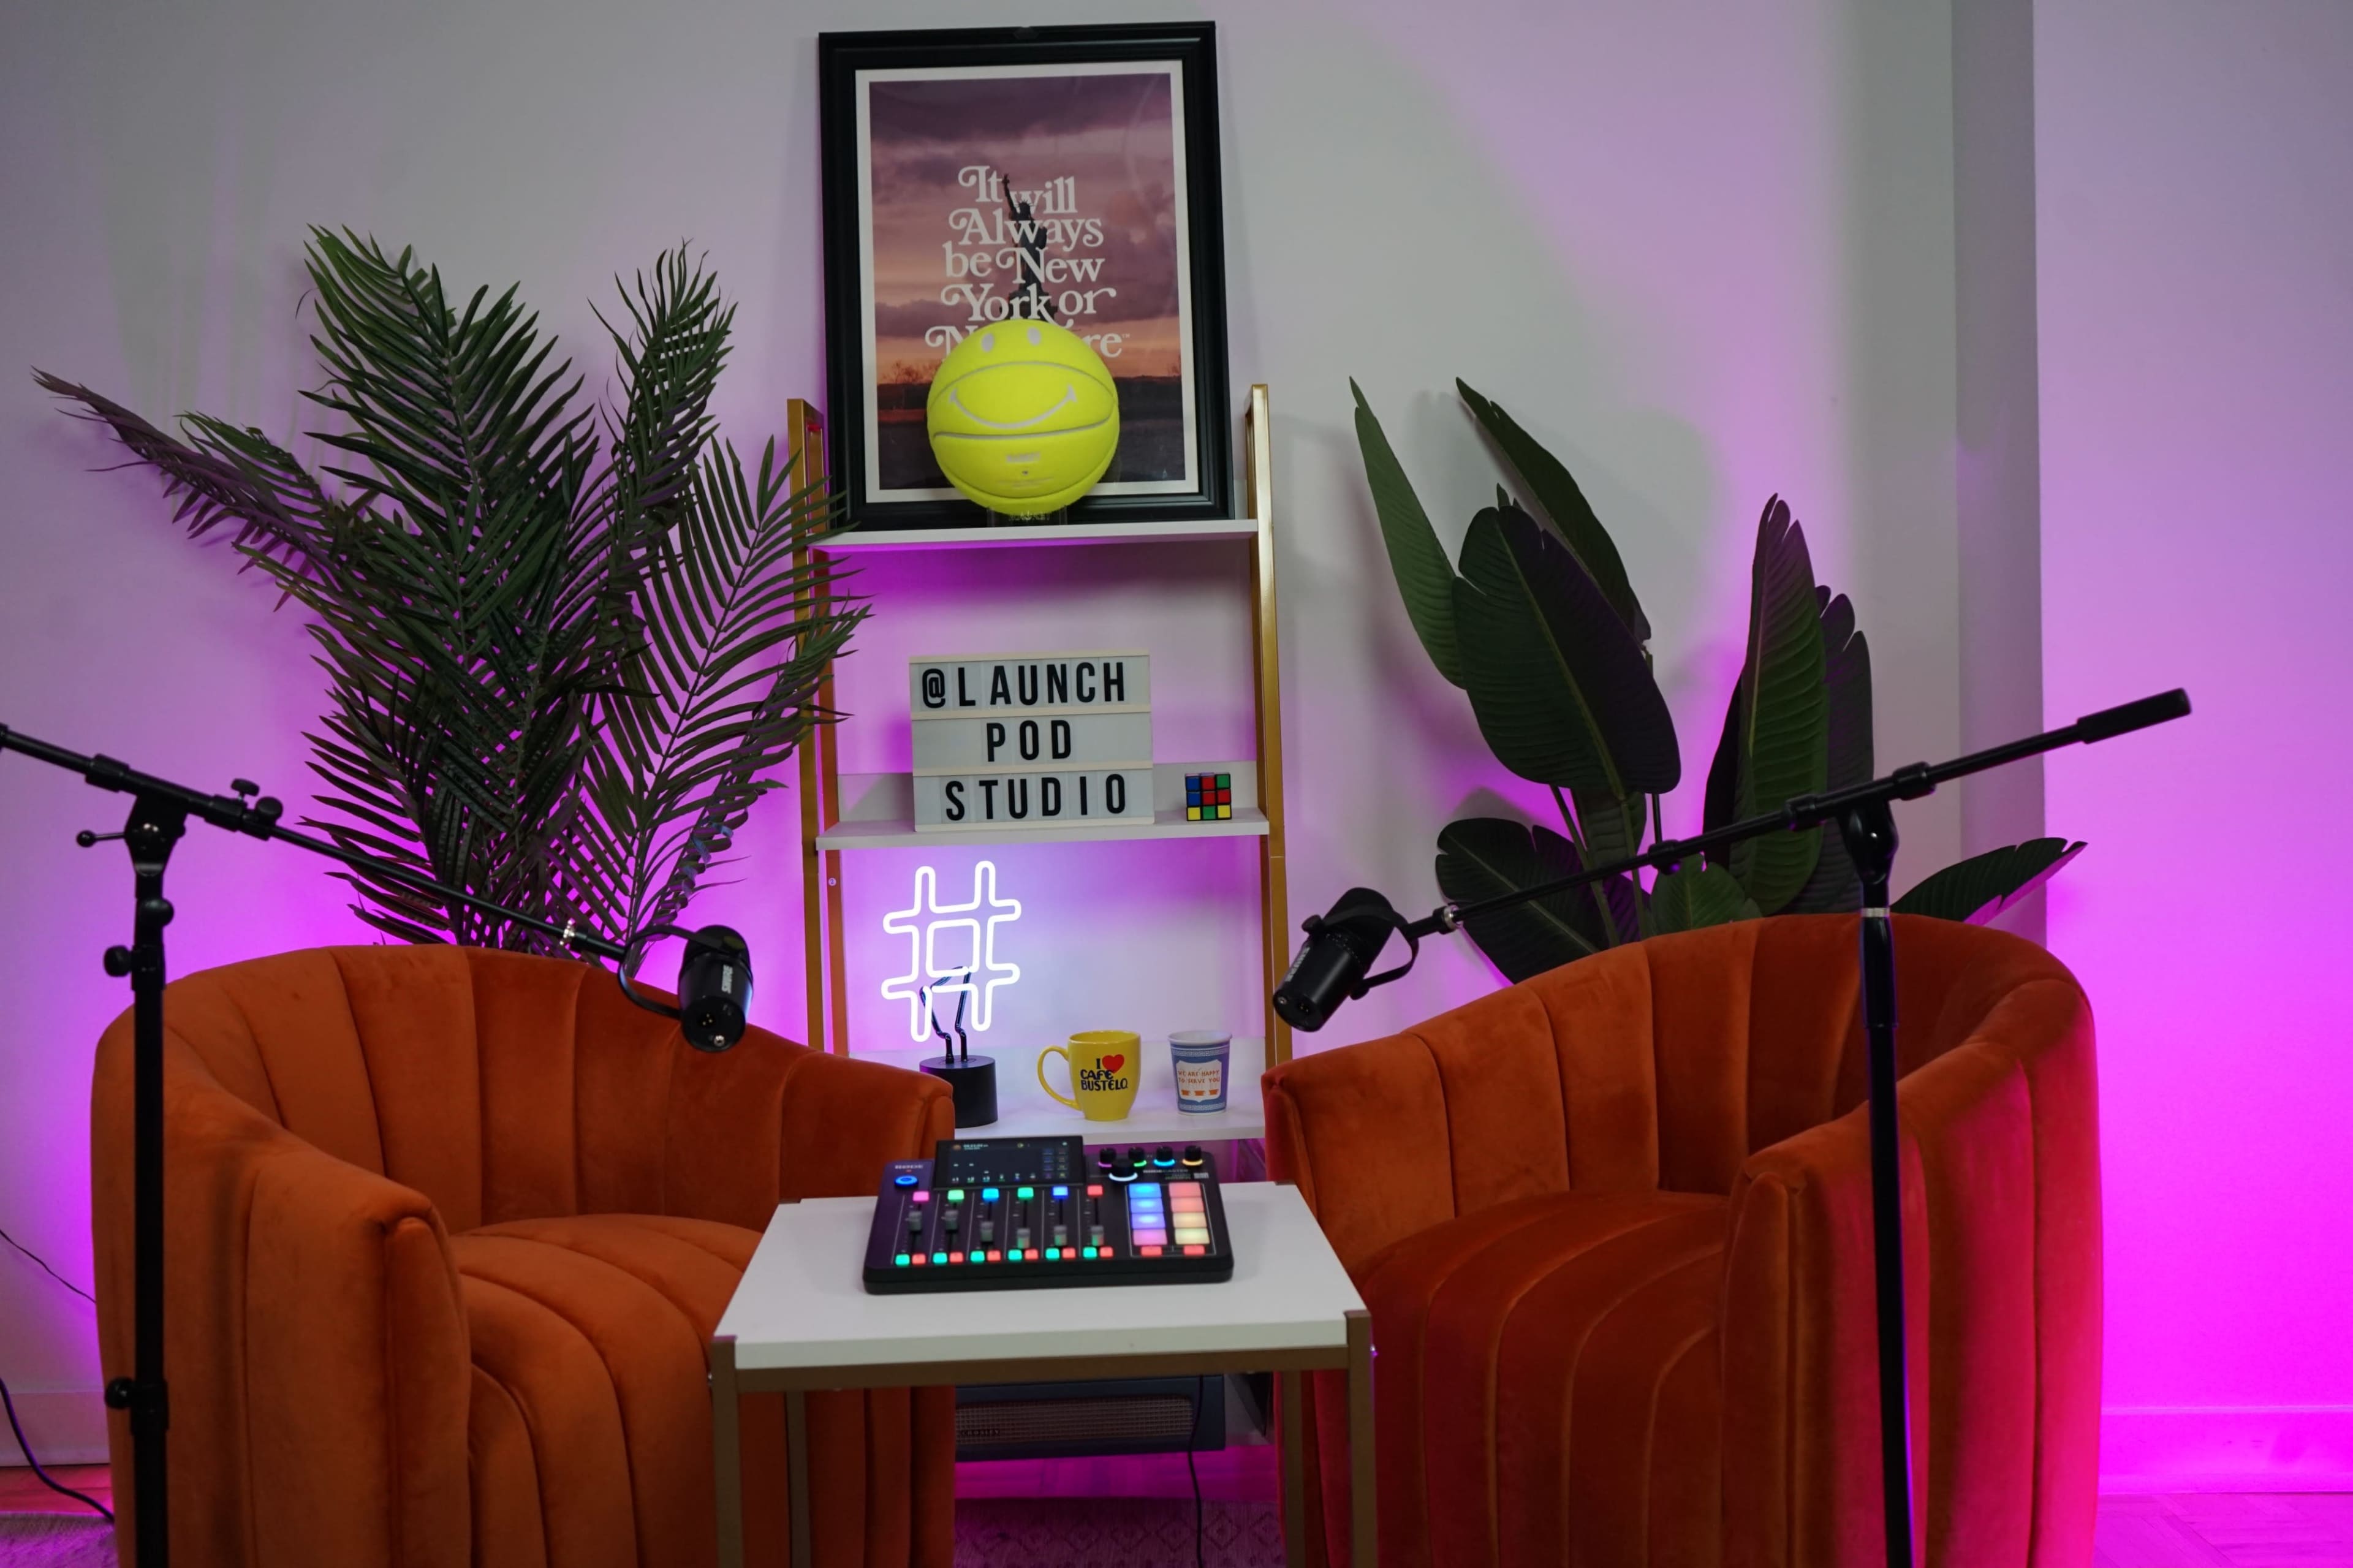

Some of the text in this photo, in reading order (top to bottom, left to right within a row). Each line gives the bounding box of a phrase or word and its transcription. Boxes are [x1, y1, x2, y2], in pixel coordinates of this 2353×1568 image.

[958, 165, 1078, 214] It will
[949, 208, 1104, 252] Always
[942, 241, 1105, 284] be New
[941, 283, 1116, 329] York or
[922, 662, 1124, 708] @LAUNCH
[987, 719, 1071, 762] POD
[945, 773, 1126, 821] STUDIO
[1080, 1069, 1113, 1080] CAFE
[1081, 1078, 1128, 1091] BUSTELO
[1096, 1058, 1101, 1069] I
